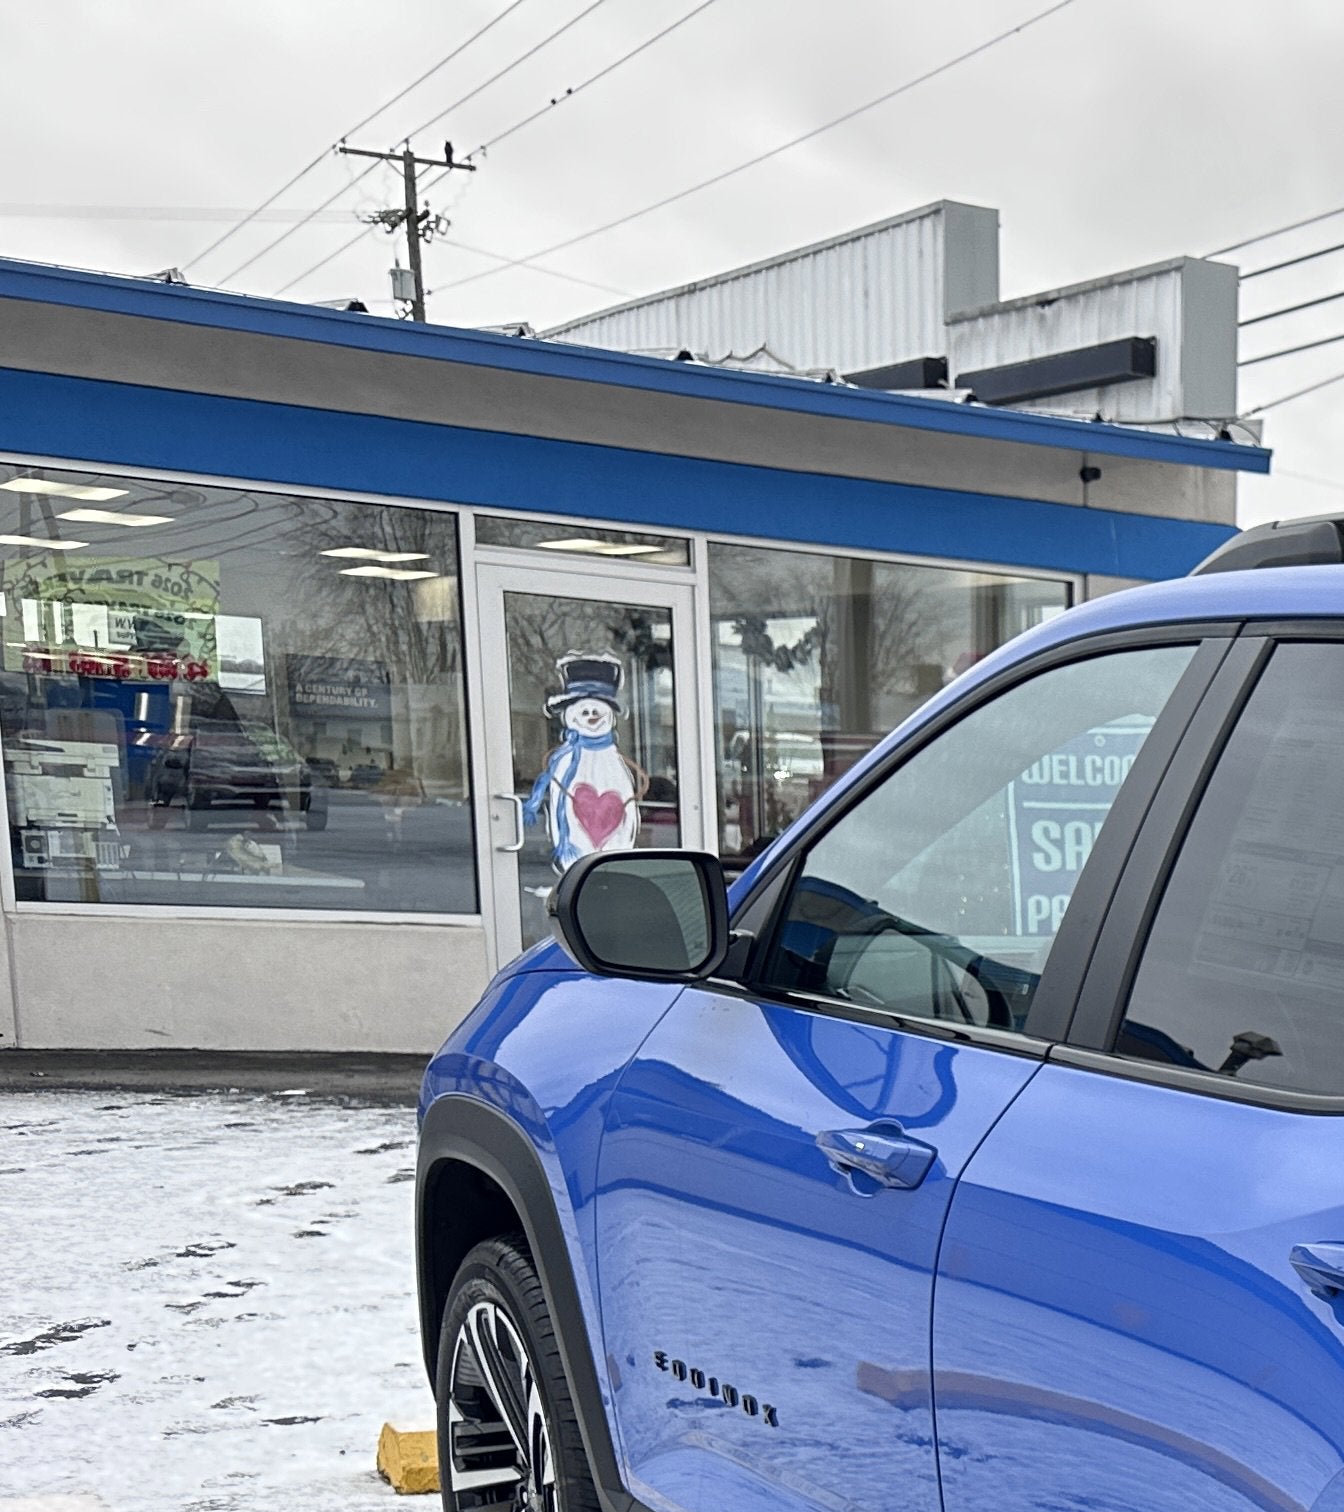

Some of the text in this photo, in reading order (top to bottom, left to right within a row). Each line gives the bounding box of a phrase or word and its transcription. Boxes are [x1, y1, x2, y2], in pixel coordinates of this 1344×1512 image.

[1031, 819, 1105, 872] SA
[1027, 894, 1071, 934] PA
[653, 1350, 780, 1428] EQUINOX
